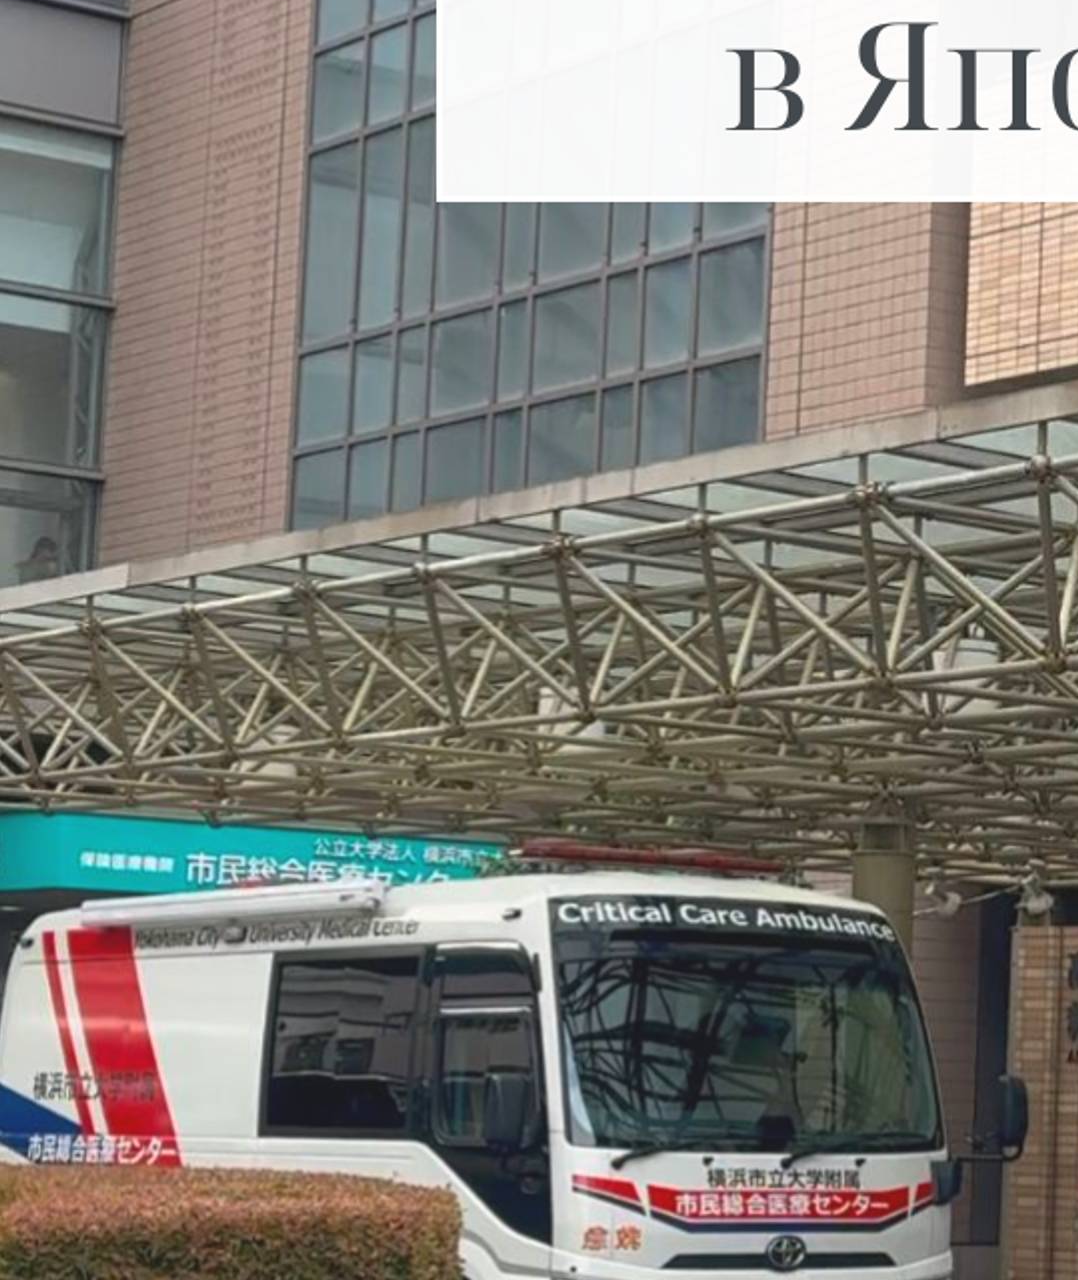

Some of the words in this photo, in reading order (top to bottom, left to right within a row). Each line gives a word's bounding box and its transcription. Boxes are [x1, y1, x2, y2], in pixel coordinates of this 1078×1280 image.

[314, 838, 416, 861] 公立大学法人
[557, 902, 671, 924] Critical
[679, 904, 748, 927] Care
[755, 908, 896, 943] Ambulance
[27, 1133, 177, 1165] 市民総合医療センター
[707, 1168, 862, 1190] 横浜市立大学附属
[675, 1194, 890, 1217] 市民総合医療センター
